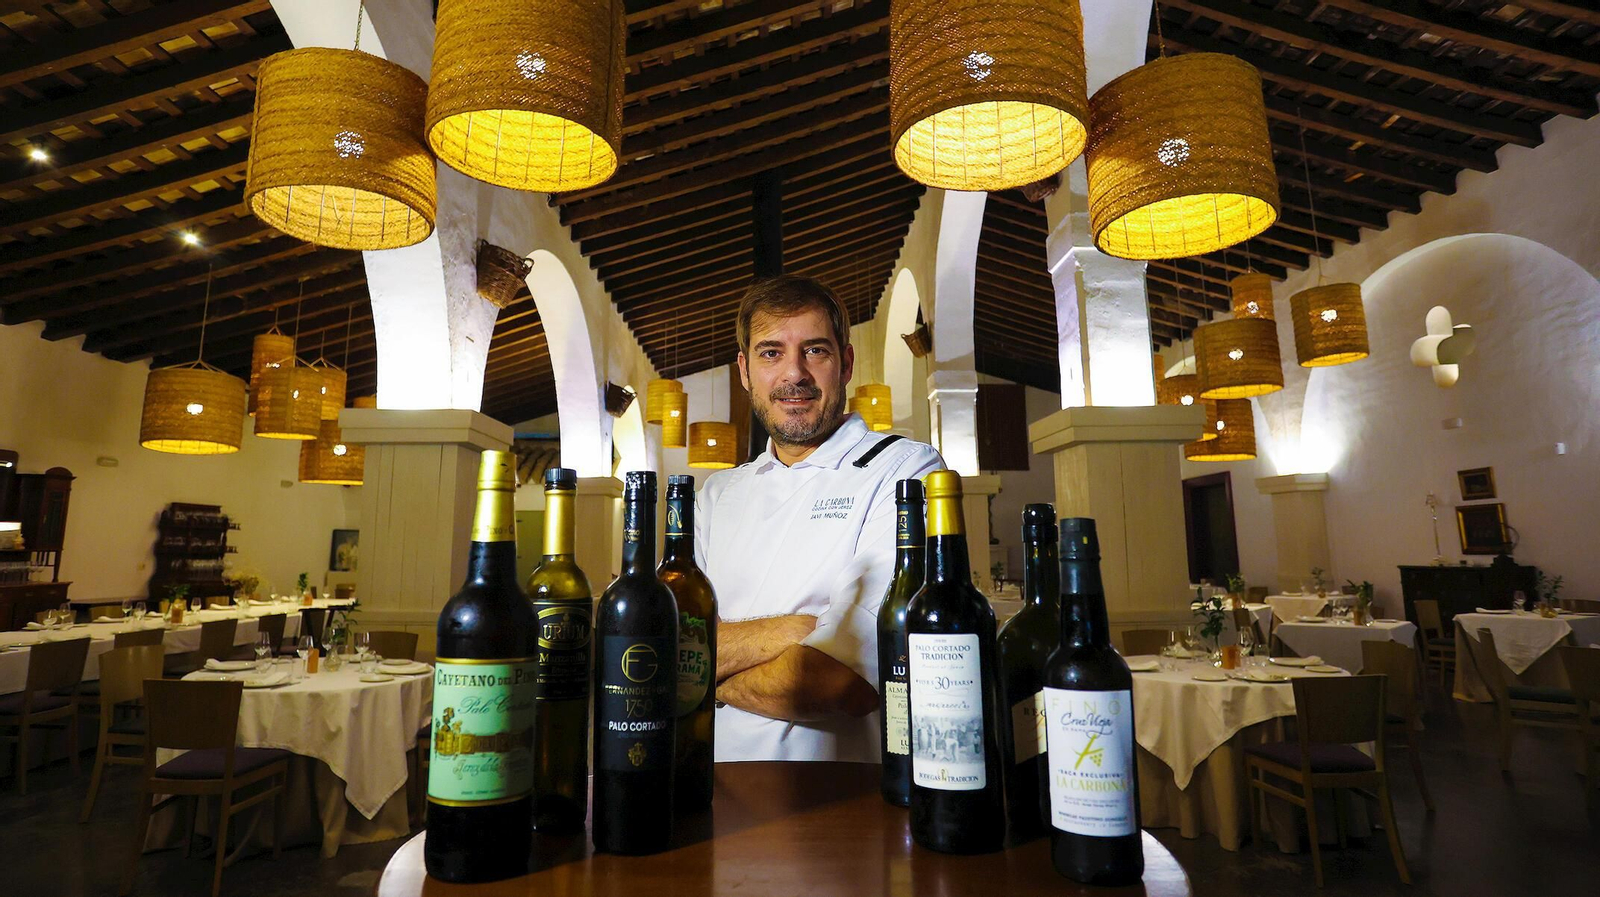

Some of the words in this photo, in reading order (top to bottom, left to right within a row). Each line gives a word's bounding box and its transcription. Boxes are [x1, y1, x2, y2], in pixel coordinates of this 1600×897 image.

[823, 511, 848, 519] MUÑOZ
[543, 624, 585, 640] URIUM
[437, 668, 496, 687] CAYETANO
[893, 666, 906, 676] LU
[935, 676, 950, 690] 30
[1052, 698, 1120, 715] FINO
[1061, 712, 1088, 726] Cruz
[608, 721, 628, 731] PALO
[629, 721, 667, 732] CORTADO
[947, 775, 979, 783] TRADICION
[1070, 779, 1127, 792] CARBONA
